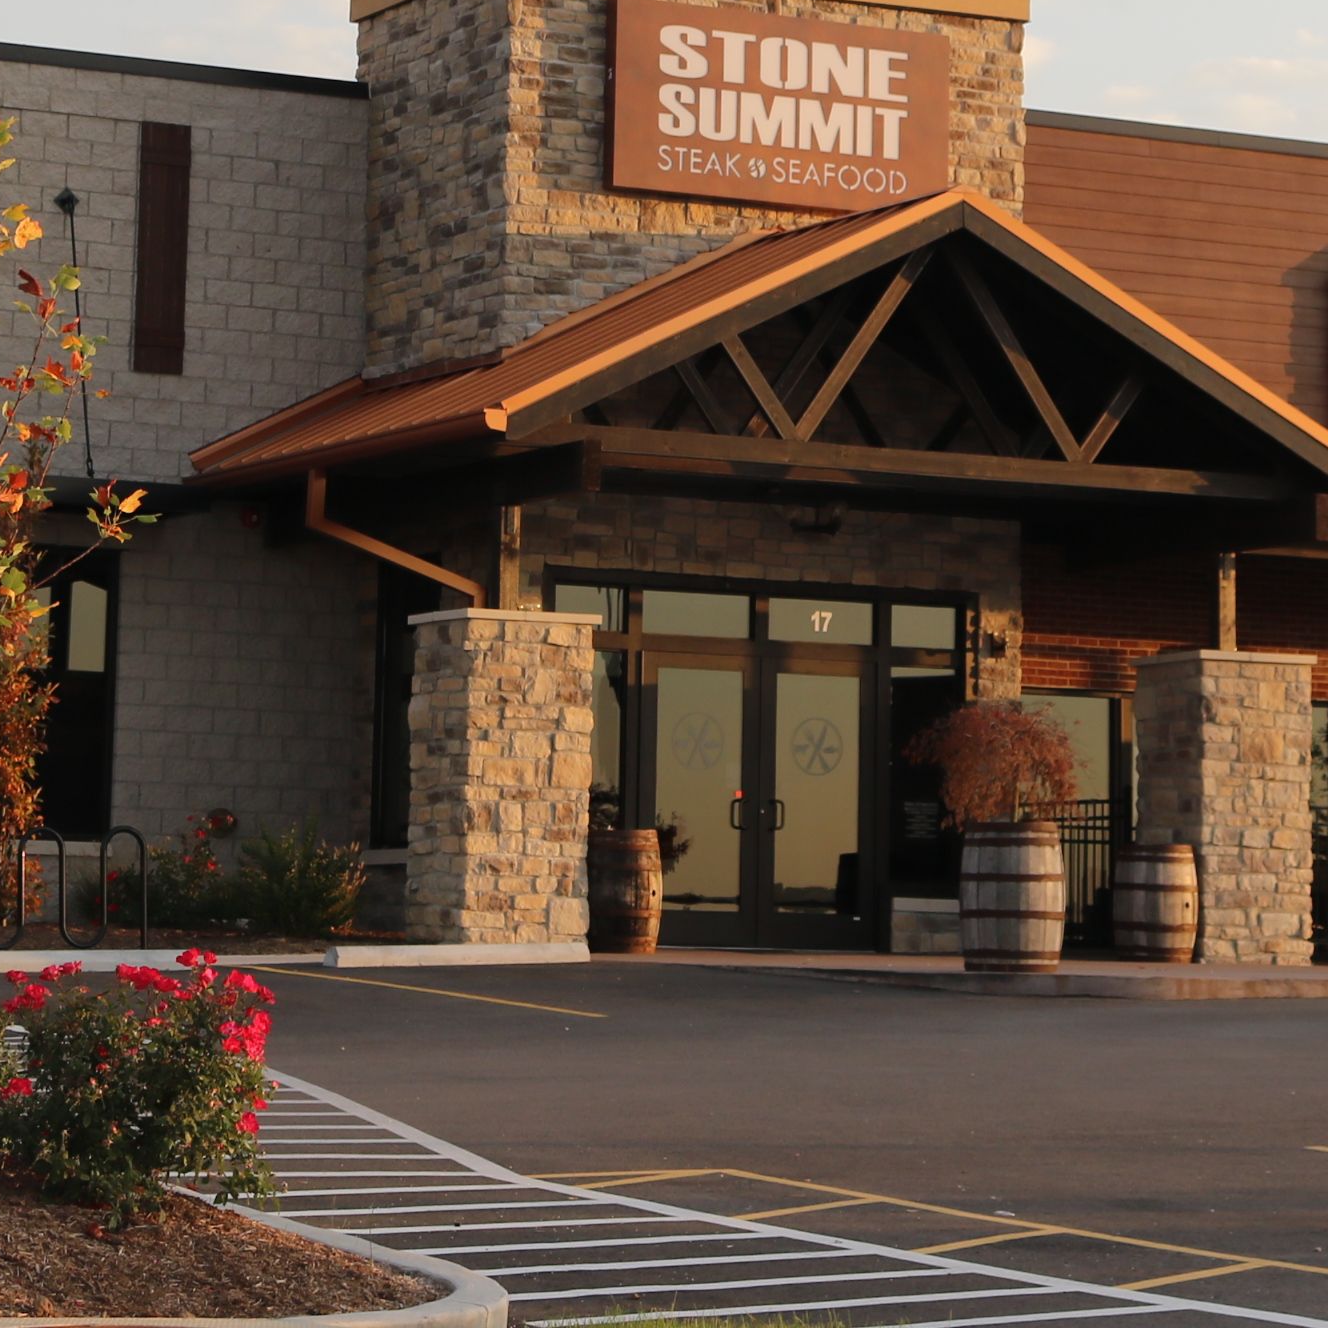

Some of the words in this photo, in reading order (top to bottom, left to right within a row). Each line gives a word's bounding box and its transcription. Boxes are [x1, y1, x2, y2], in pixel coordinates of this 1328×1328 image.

[659, 25, 909, 103] STONE
[658, 83, 908, 160] SUMMIT
[657, 145, 741, 178] STEAK
[772, 157, 908, 195] SEAFOOD
[811, 610, 833, 633] 17
